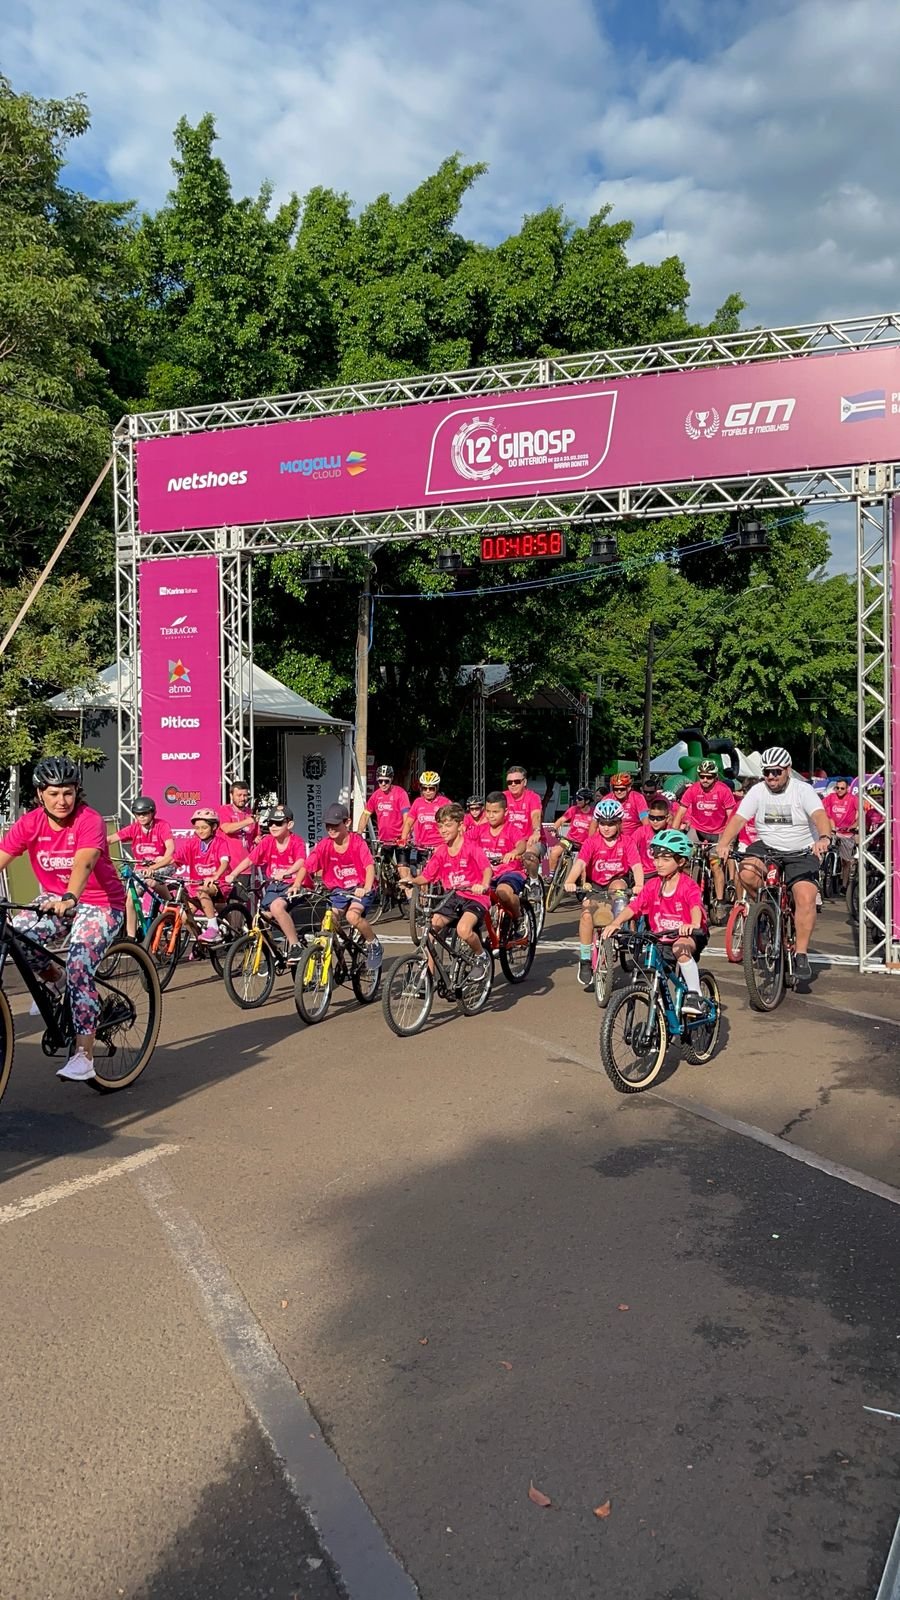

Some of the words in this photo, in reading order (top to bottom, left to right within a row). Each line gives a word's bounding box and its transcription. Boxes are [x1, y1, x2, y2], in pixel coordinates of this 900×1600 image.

[724, 398, 796, 427] GM
[498, 429, 576, 460] GIROSP
[508, 459, 518, 468] DO
[518, 455, 548, 467] INTERIOR
[312, 469, 342, 480] CLOUD
[483, 532, 561, 560] 00:48:58
[168, 684, 192, 694] atmo
[161, 716, 200, 729] Piticas
[161, 752, 200, 761] BANDUP
[306, 784, 316, 849] MACATUBA
